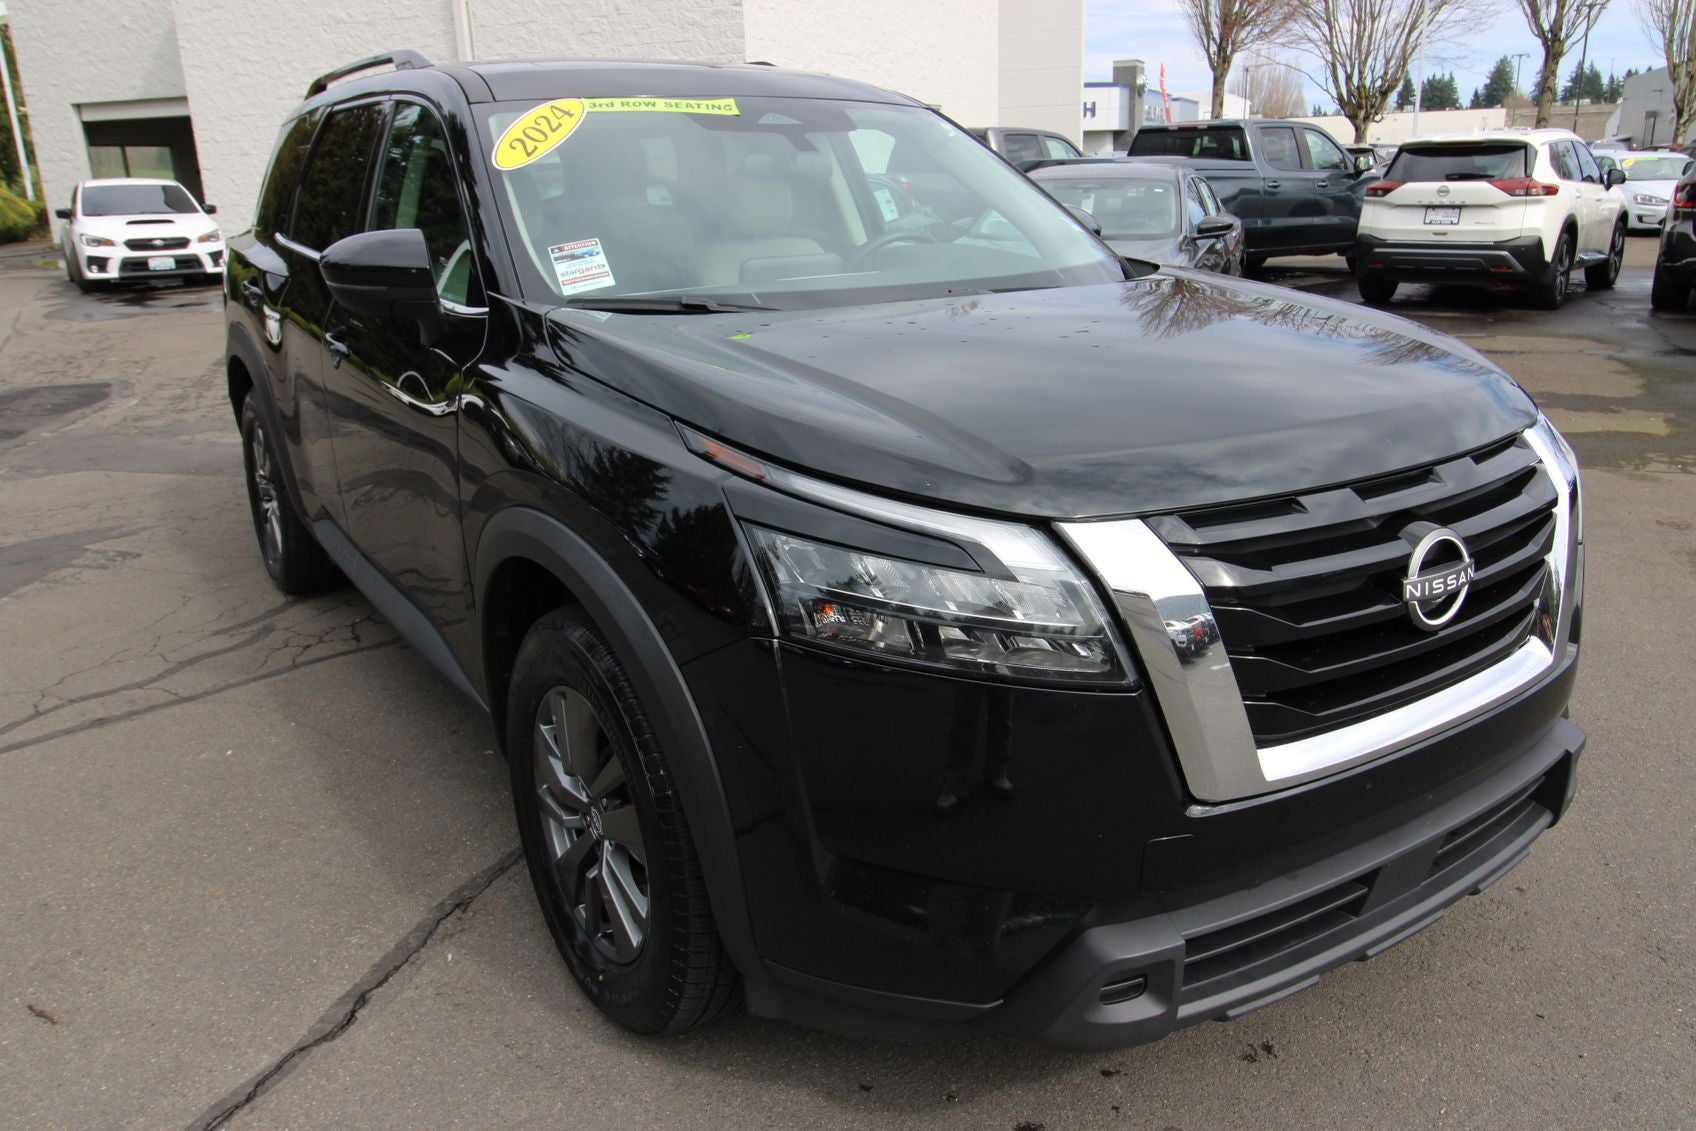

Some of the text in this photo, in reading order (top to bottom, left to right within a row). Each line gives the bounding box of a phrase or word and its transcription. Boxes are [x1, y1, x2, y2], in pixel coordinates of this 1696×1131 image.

[588, 101, 615, 109] 3rd
[663, 101, 733, 112] SEATING
[509, 104, 575, 158] 2024
[564, 240, 597, 251] ATTENTION
[1406, 566, 1475, 599] NISSAN
